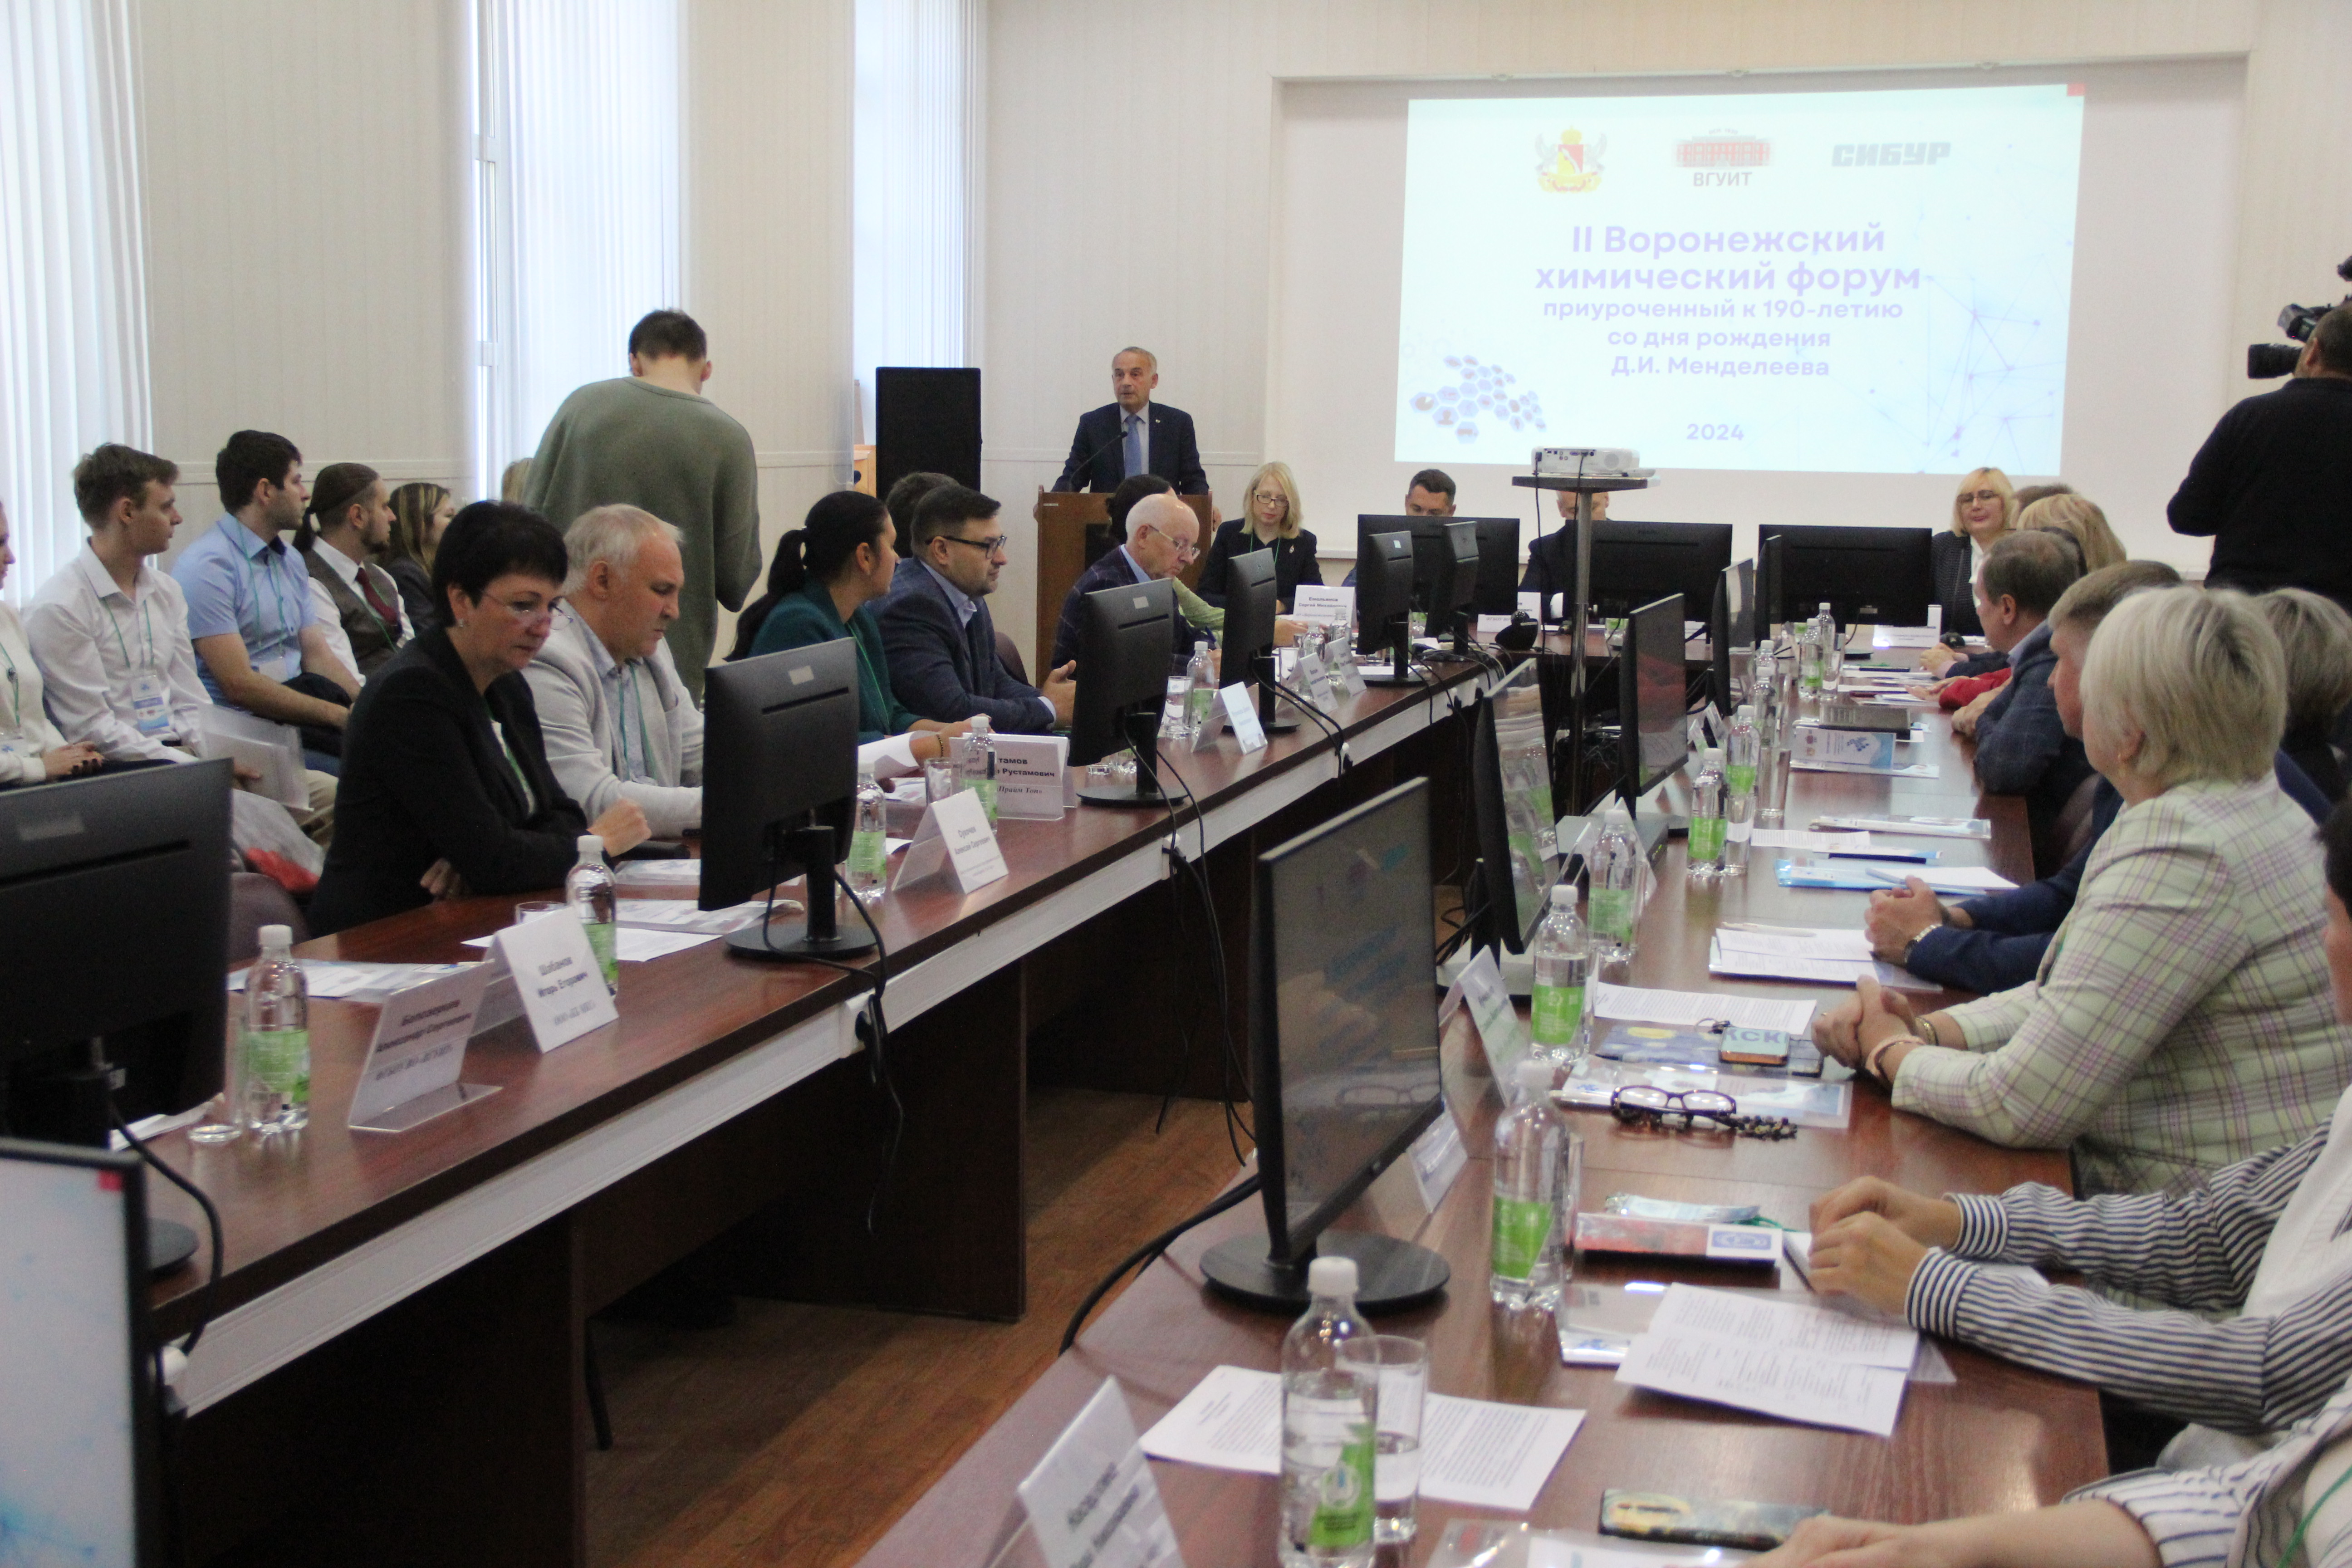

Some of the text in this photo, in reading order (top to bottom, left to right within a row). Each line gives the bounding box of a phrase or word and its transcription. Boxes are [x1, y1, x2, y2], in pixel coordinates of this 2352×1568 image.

[1832, 142, 1951, 167] СИБУР
[1693, 172, 1752, 187] ВГУИТ
[1573, 222, 1884, 260] II Воронежский
[1536, 260, 1920, 296] химический форум
[1544, 299, 1903, 321] приуроченный к 190-летию
[1607, 331, 1830, 350] со дня рождения
[1611, 356, 1829, 377] Д.И. Менделеева
[1687, 423, 1744, 441] 2024
[1003, 768, 1055, 777] Рустамович
[538, 971, 588, 997] Игорь Егорович
